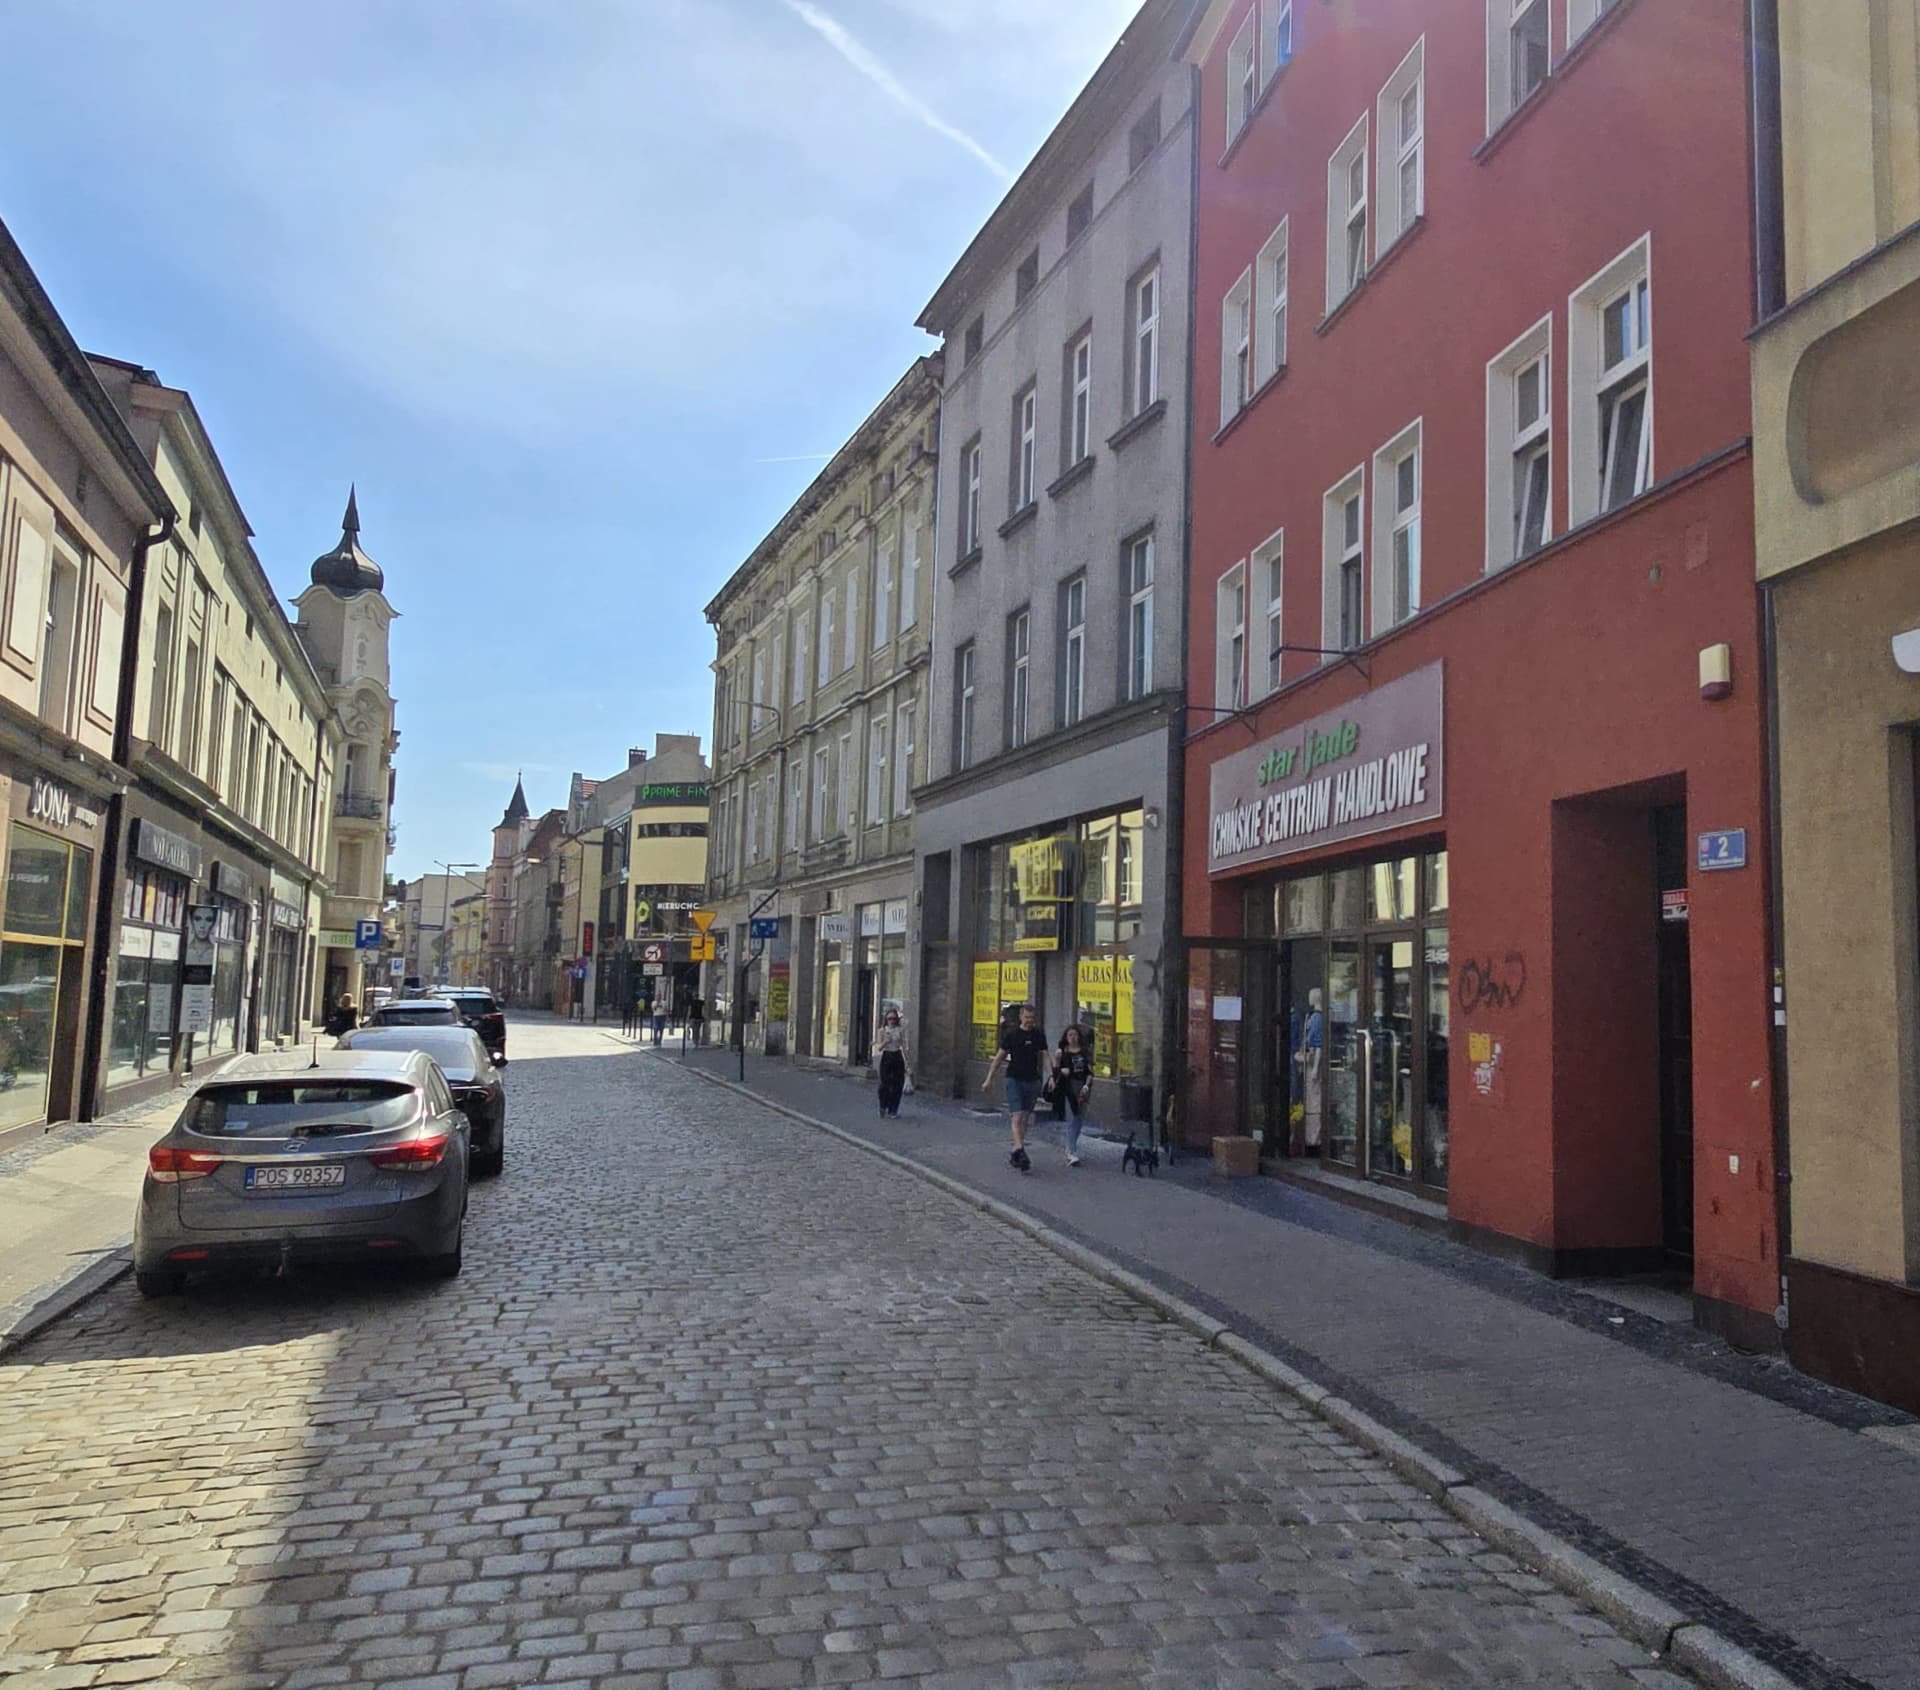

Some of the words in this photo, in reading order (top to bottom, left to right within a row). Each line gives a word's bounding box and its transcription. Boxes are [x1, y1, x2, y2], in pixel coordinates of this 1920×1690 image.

[1257, 747, 1297, 787] star
[1303, 720, 1359, 777] jade
[651, 785, 681, 798] PRIME
[1213, 798, 1263, 859] CHIŃSKIE
[1264, 776, 1333, 845] CENTRUM
[1334, 744, 1429, 825] HANDLOWE
[1717, 836, 1729, 858] 2
[361, 922, 377, 941] P
[1003, 967, 1027, 983] ALBAS
[1081, 965, 1112, 984] ALBAS
[255, 1168, 289, 1184] POS
[292, 1167, 343, 1184] 98357
